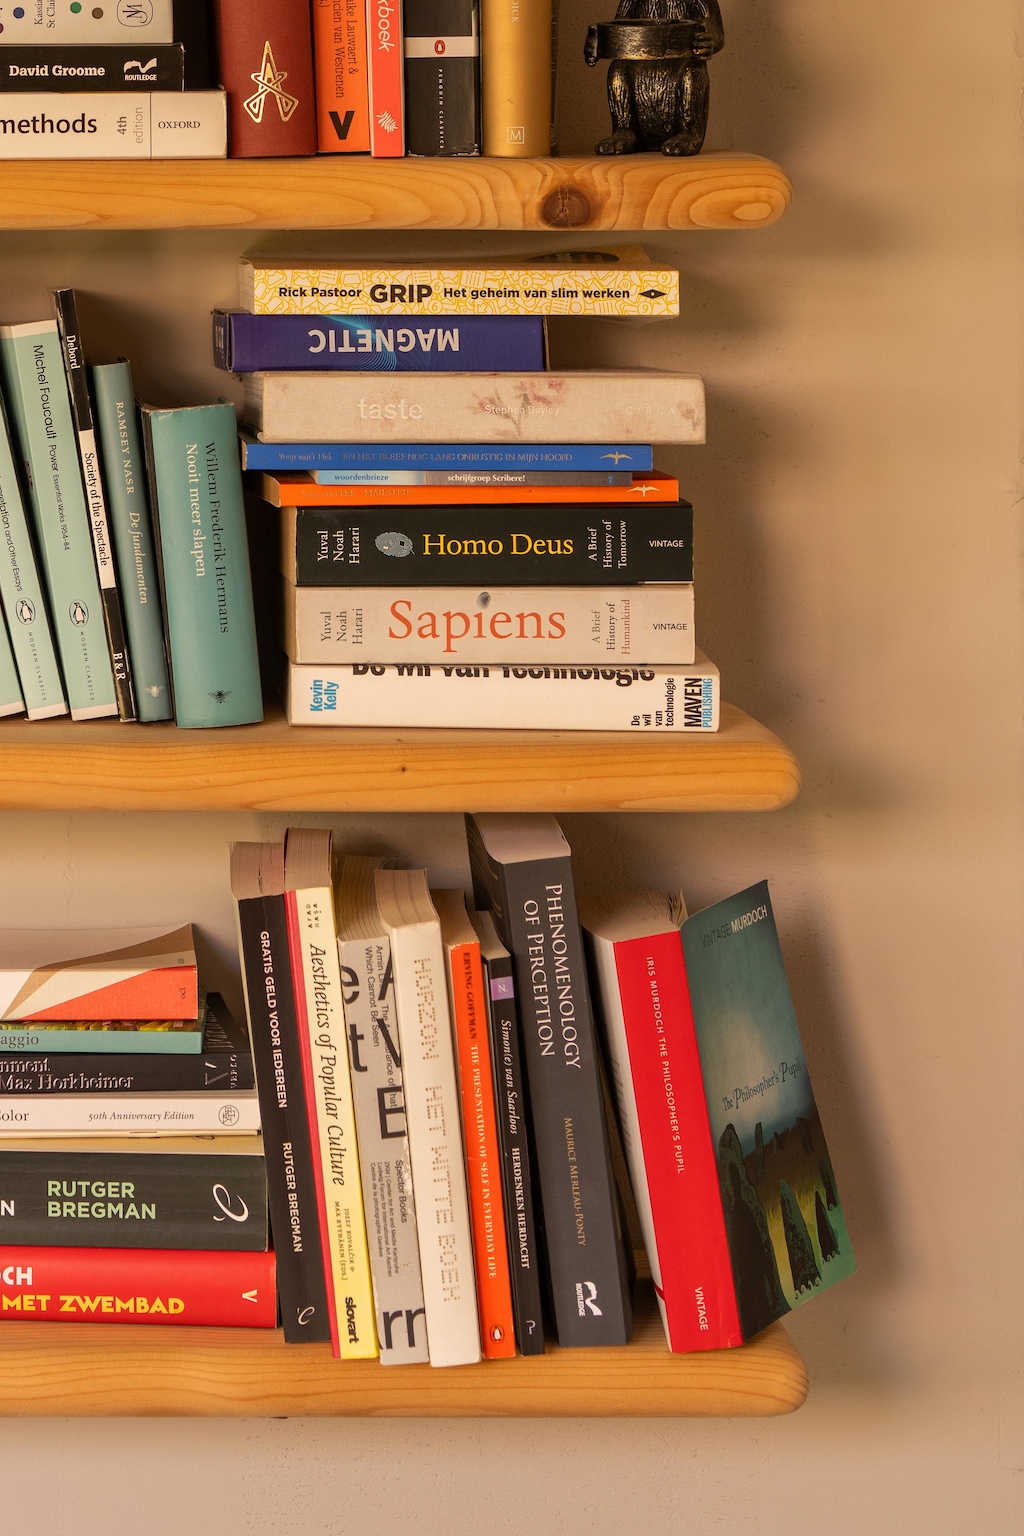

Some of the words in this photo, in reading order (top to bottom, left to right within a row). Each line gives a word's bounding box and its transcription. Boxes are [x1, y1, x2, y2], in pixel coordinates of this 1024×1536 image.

[9, 65, 46, 76] David
[50, 66, 105, 77] Groome
[158, 121, 201, 129] OXFORD
[279, 287, 306, 298] Rick
[311, 287, 362, 298] Pastoor
[370, 284, 433, 303] GRIP
[308, 328, 459, 352] MAGNETIC
[358, 398, 423, 420] taste
[422, 534, 503, 556] Homo
[510, 534, 573, 556] Deus
[649, 540, 684, 548] VINTAGE
[388, 600, 566, 653] Sapiens
[684, 678, 702, 727] MAVEN
[703, 678, 712, 727] PUBLISHING
[524, 900, 539, 925] OF
[260, 931, 272, 973] GRATIS
[546, 884, 581, 1069] PHENOMENOLOGY
[264, 976, 275, 1009] GELD
[528, 934, 555, 1056] PERCEPTION
[269, 1012, 280, 1049] VOOR
[272, 1049, 288, 1108] IEDEREEN
[48, 1181, 135, 1198] RUTGER
[48, 1201, 156, 1219] BREGMAN
[2, 1294, 50, 1312] MET
[59, 1294, 185, 1315] ZWEMBAD
[695, 1287, 708, 1331] VINTAGE
[345, 1297, 359, 1343] slovart
